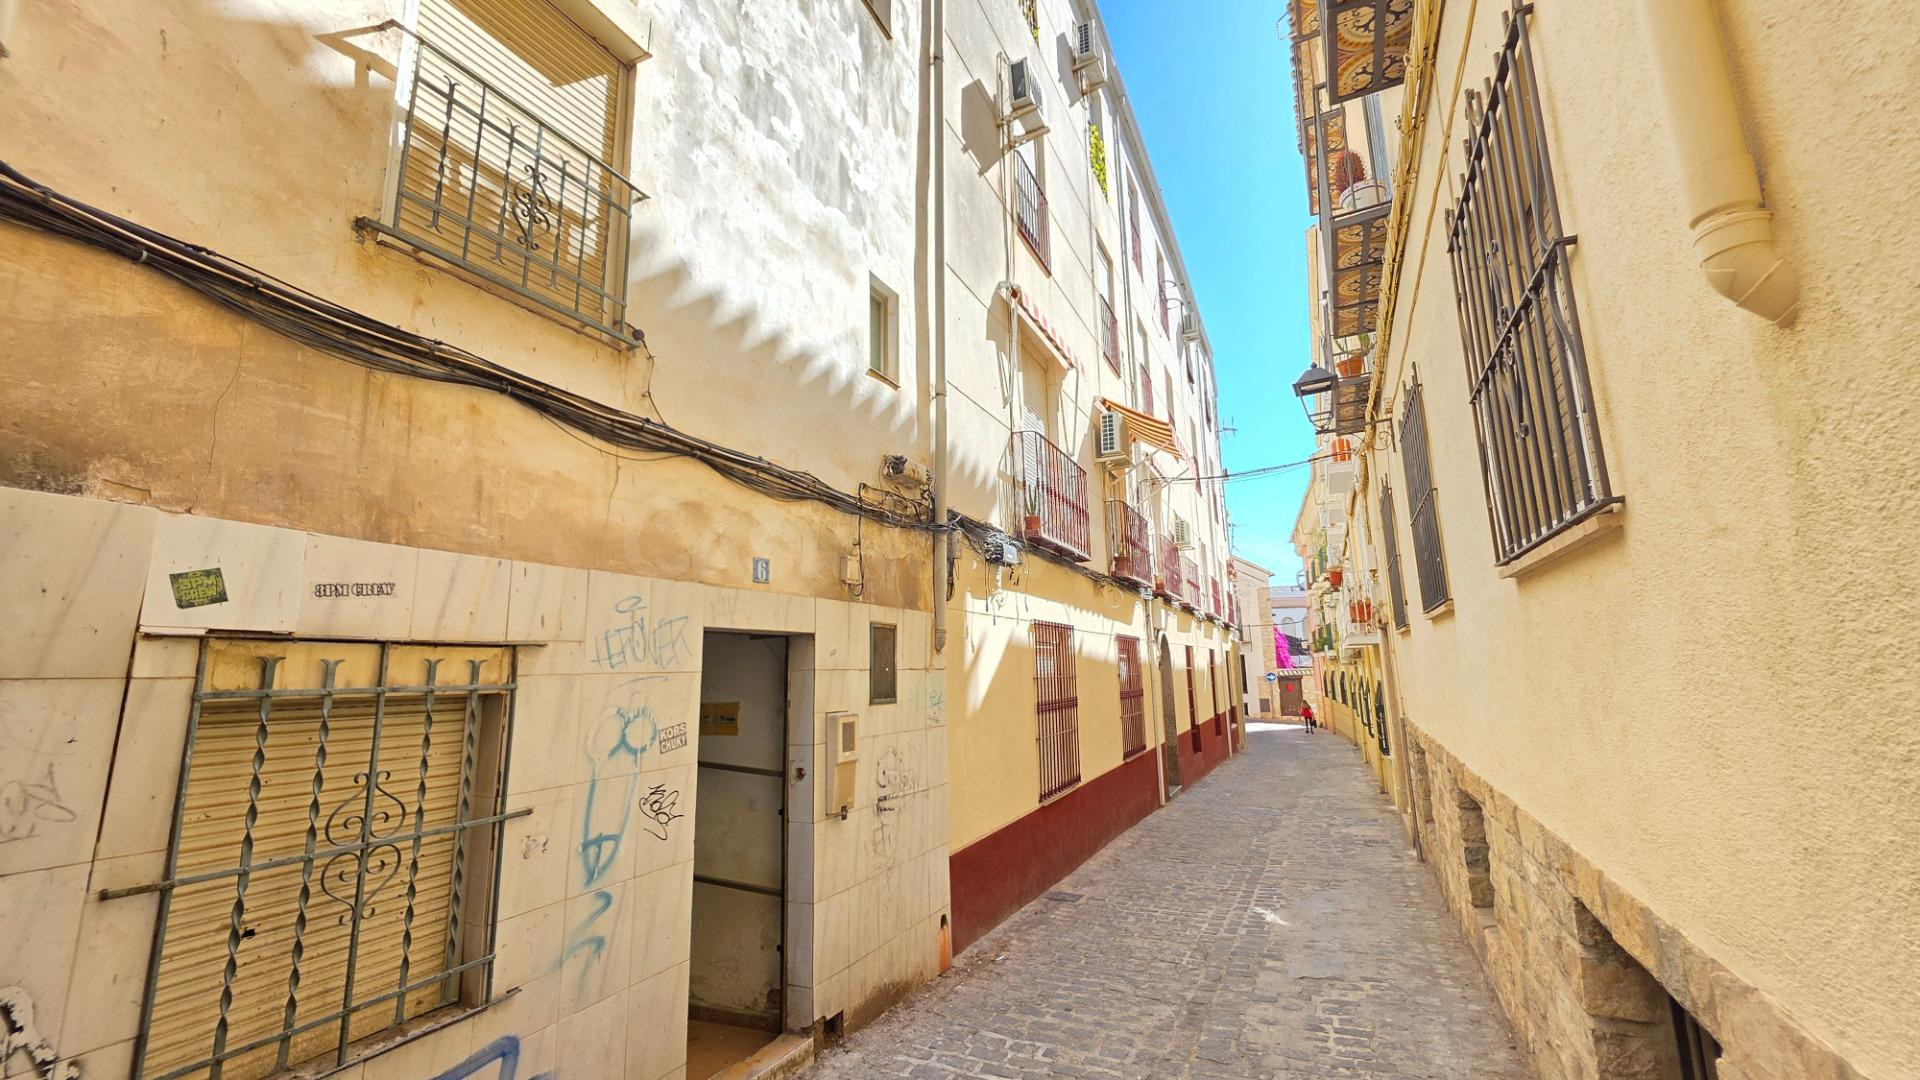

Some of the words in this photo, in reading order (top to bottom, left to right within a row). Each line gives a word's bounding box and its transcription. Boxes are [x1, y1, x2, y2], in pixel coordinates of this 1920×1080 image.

[757, 560, 767, 581] 6
[315, 583, 349, 598] 3PM
[351, 582, 395, 597] CREW
[659, 723, 686, 741] KORS
[660, 735, 687, 753] CHUKY
